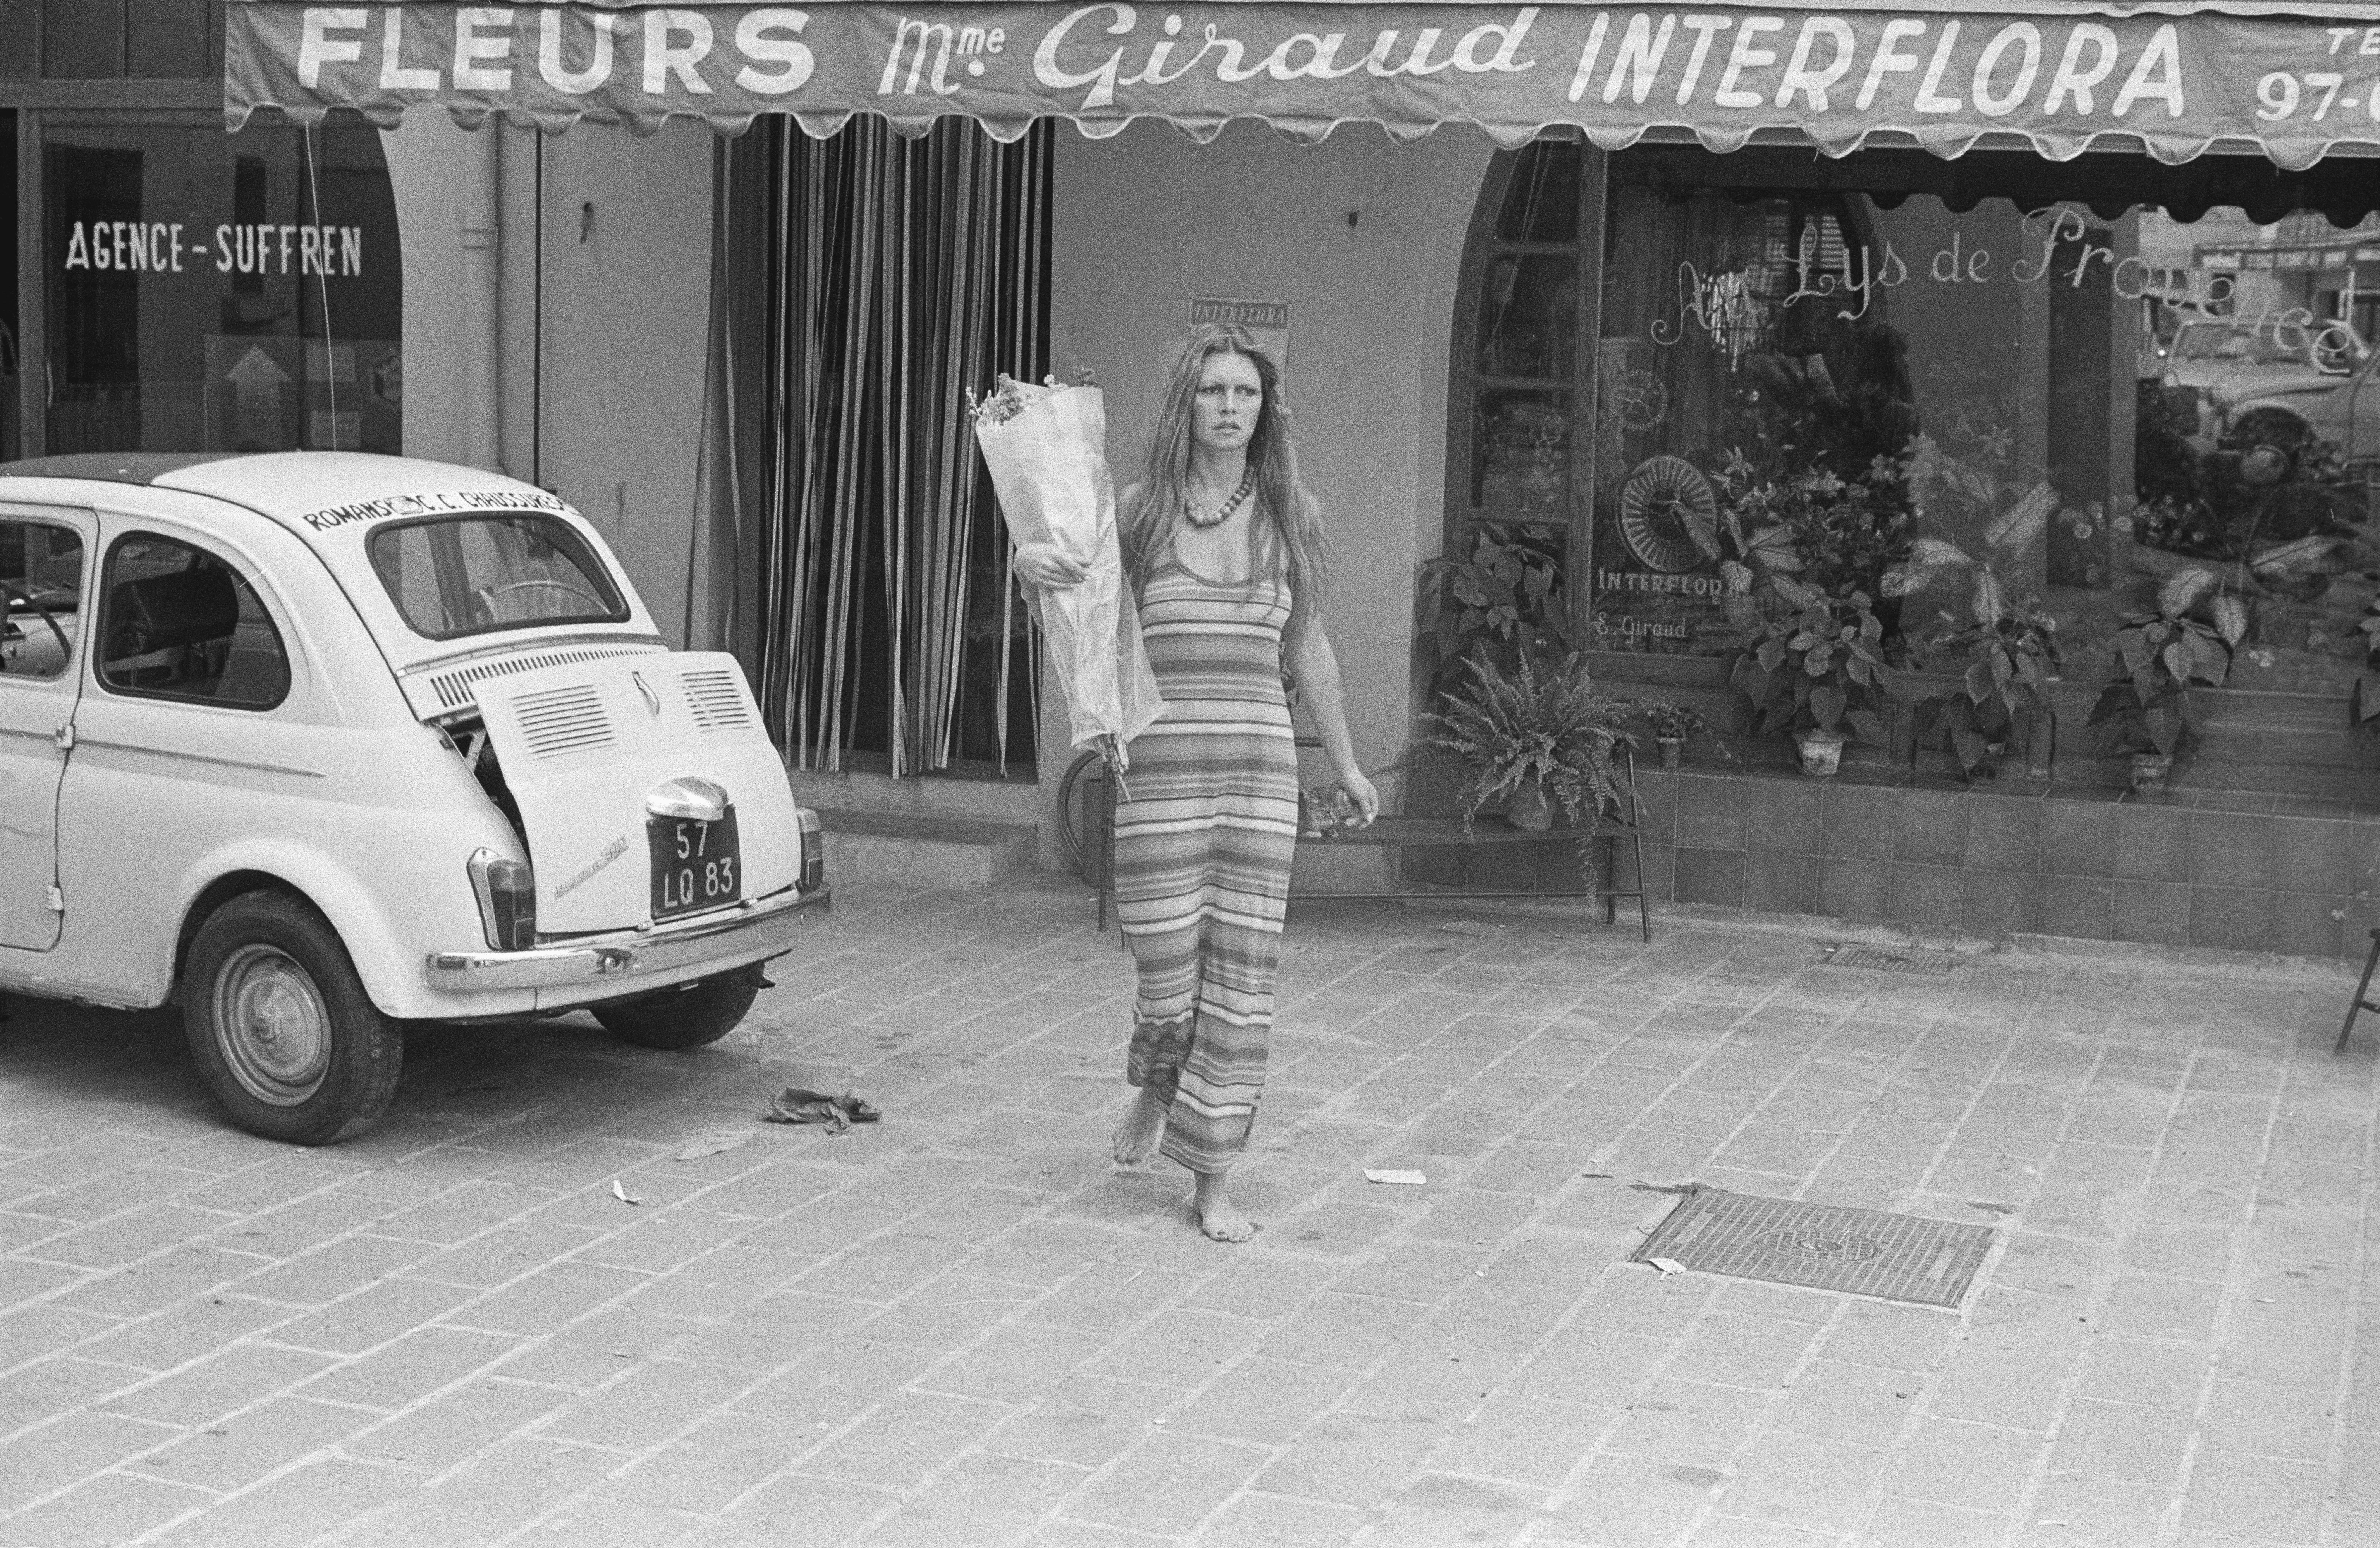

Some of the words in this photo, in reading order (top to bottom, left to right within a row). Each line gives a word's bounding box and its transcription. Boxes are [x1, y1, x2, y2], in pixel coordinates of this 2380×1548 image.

[297, 7, 815, 95] FLEURS
[1033, 3, 1541, 110] Giraud
[1568, 12, 2185, 118] INTERFLORA
[2256, 72, 2380, 122] 97-
[1782, 225, 1911, 320] Lys
[1929, 232, 1992, 284] de
[2014, 206, 2351, 374] Provence
[302, 499, 393, 532] ROMANS
[1622, 615, 1687, 645] Giraud
[677, 820, 708, 860] 57
[706, 857, 733, 897] 83
